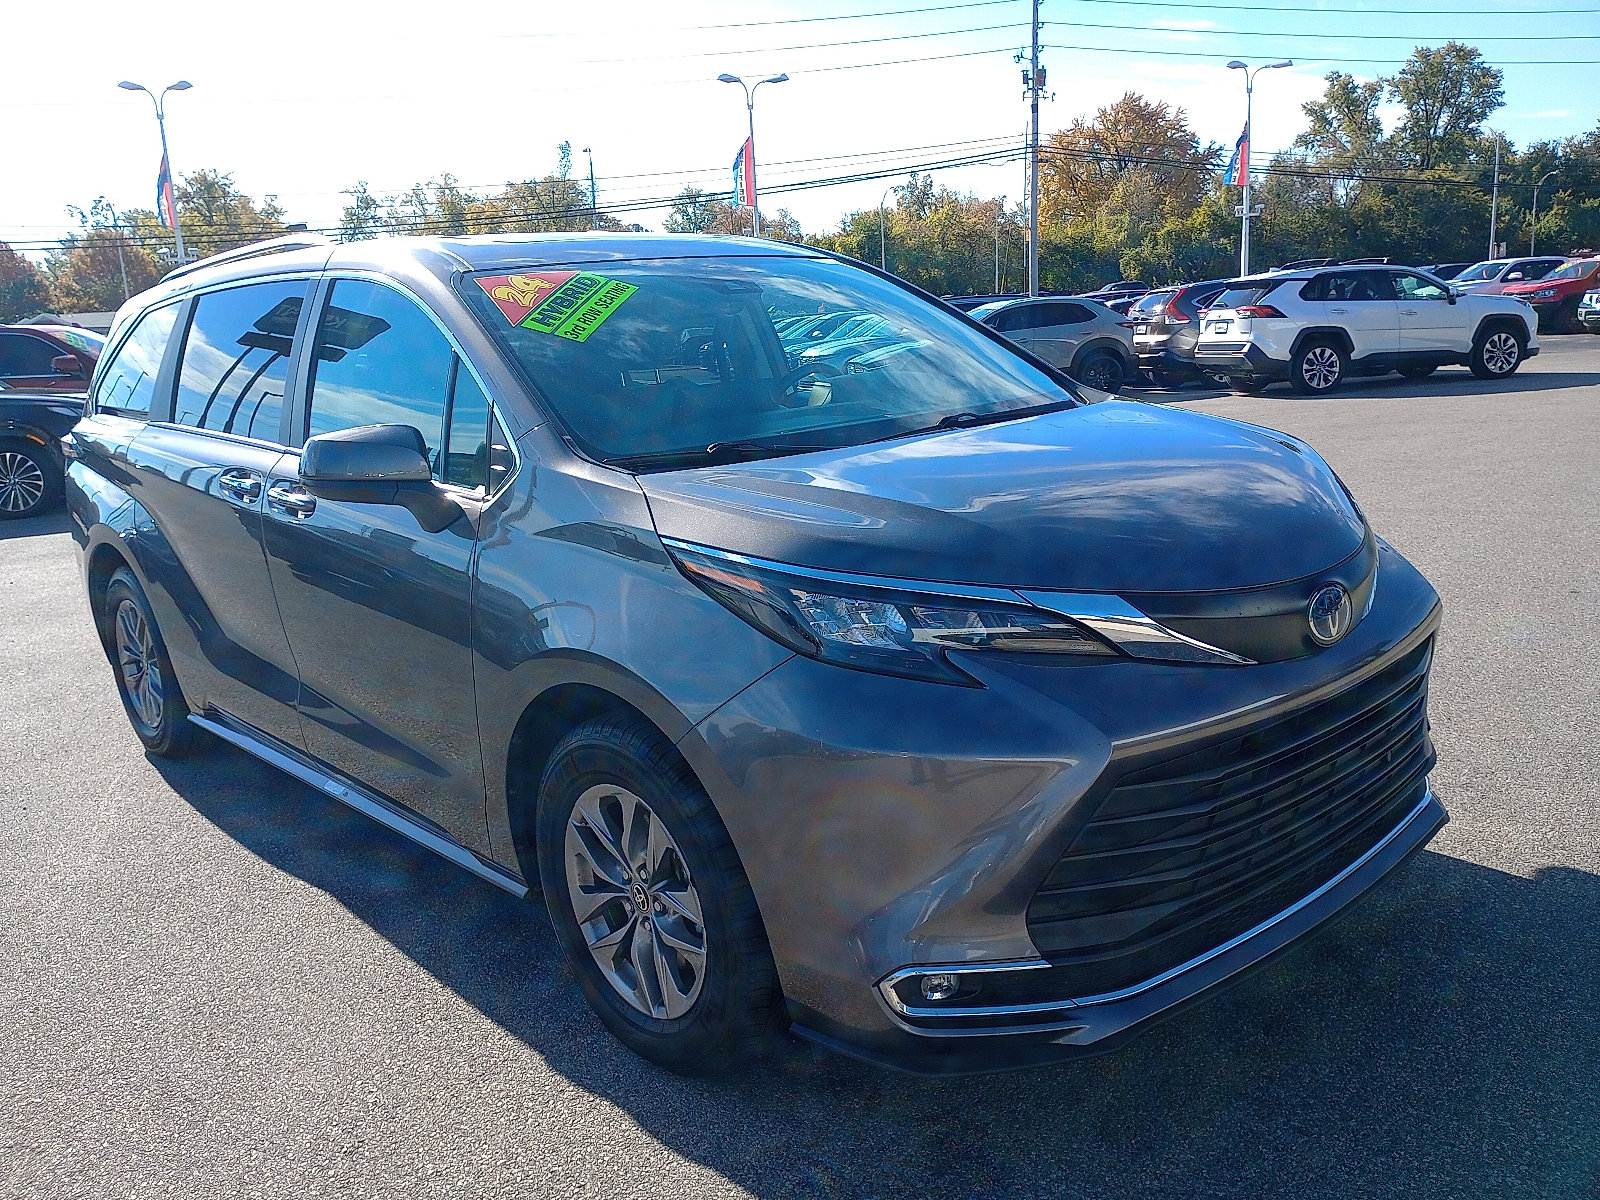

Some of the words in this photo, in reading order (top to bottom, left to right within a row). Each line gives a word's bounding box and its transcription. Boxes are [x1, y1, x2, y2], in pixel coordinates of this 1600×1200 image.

[492, 275, 556, 307] 24
[532, 276, 601, 327] HYBRID
[564, 323, 586, 339] 3rd
[581, 307, 604, 326] ROW
[594, 282, 631, 310] SEATING
